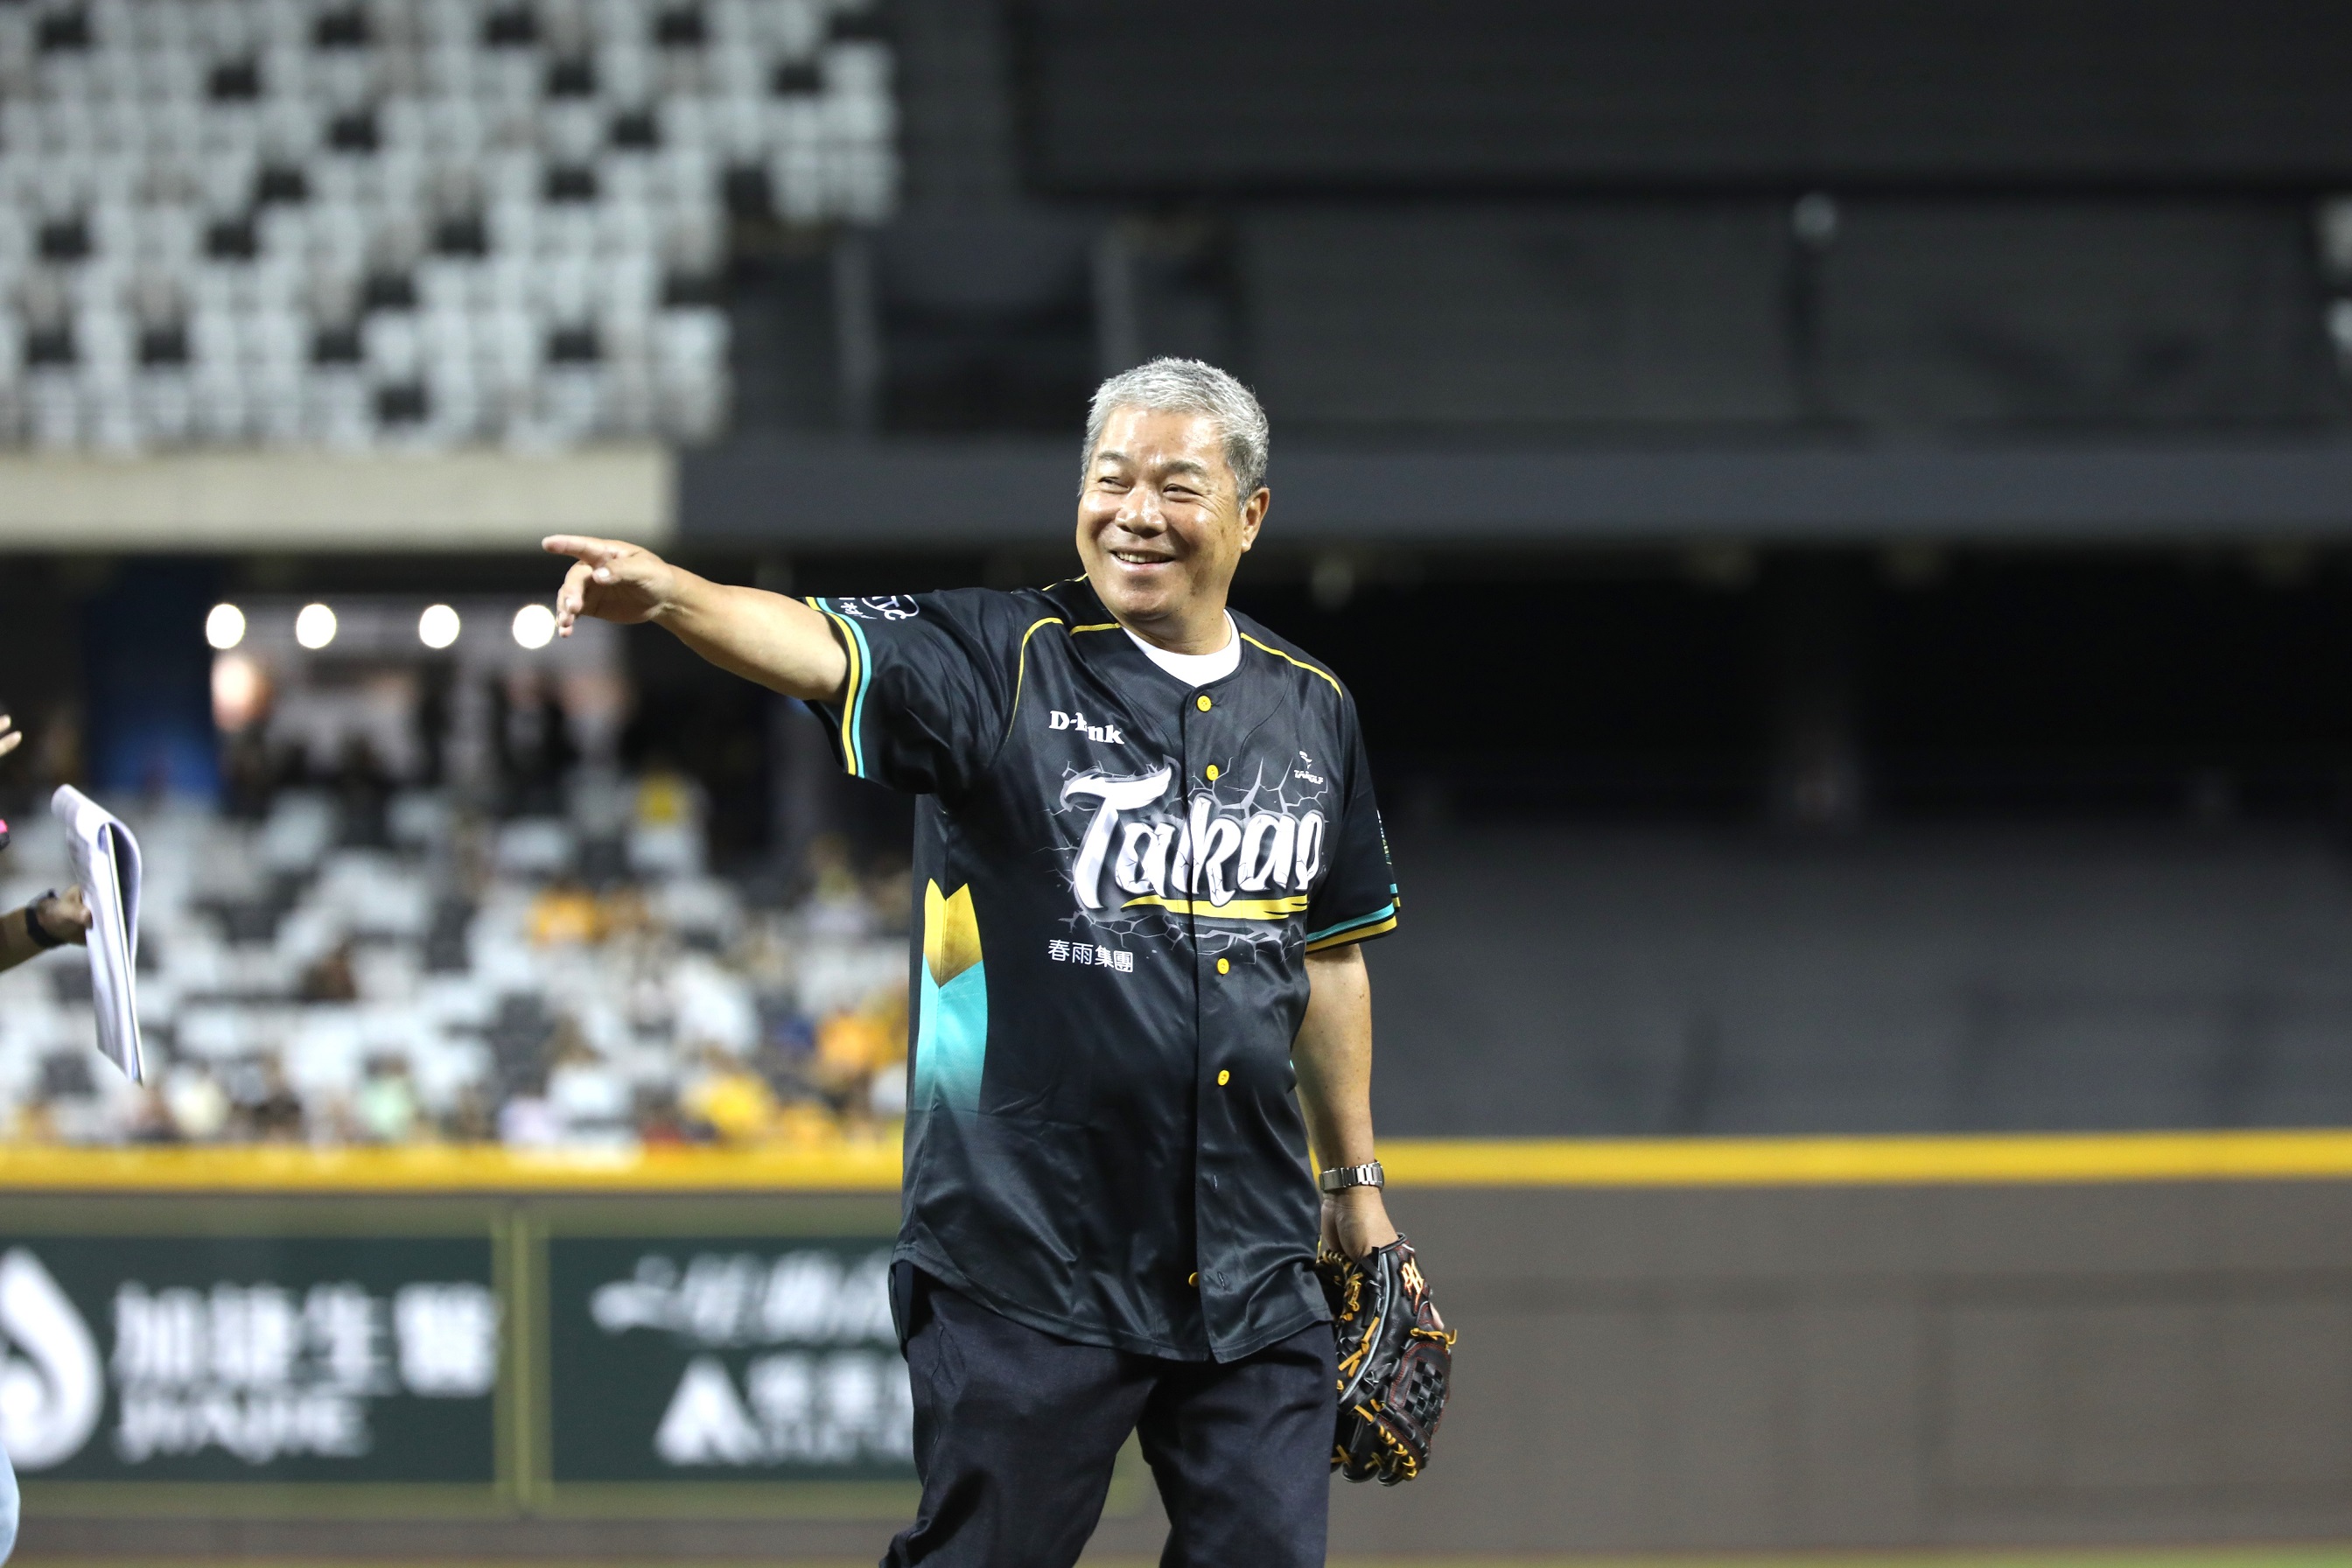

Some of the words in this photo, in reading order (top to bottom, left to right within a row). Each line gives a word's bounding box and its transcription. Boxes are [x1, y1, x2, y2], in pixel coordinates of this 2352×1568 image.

[1063, 762, 1324, 910] Takao
[1047, 939, 1134, 973] 春雨集團
